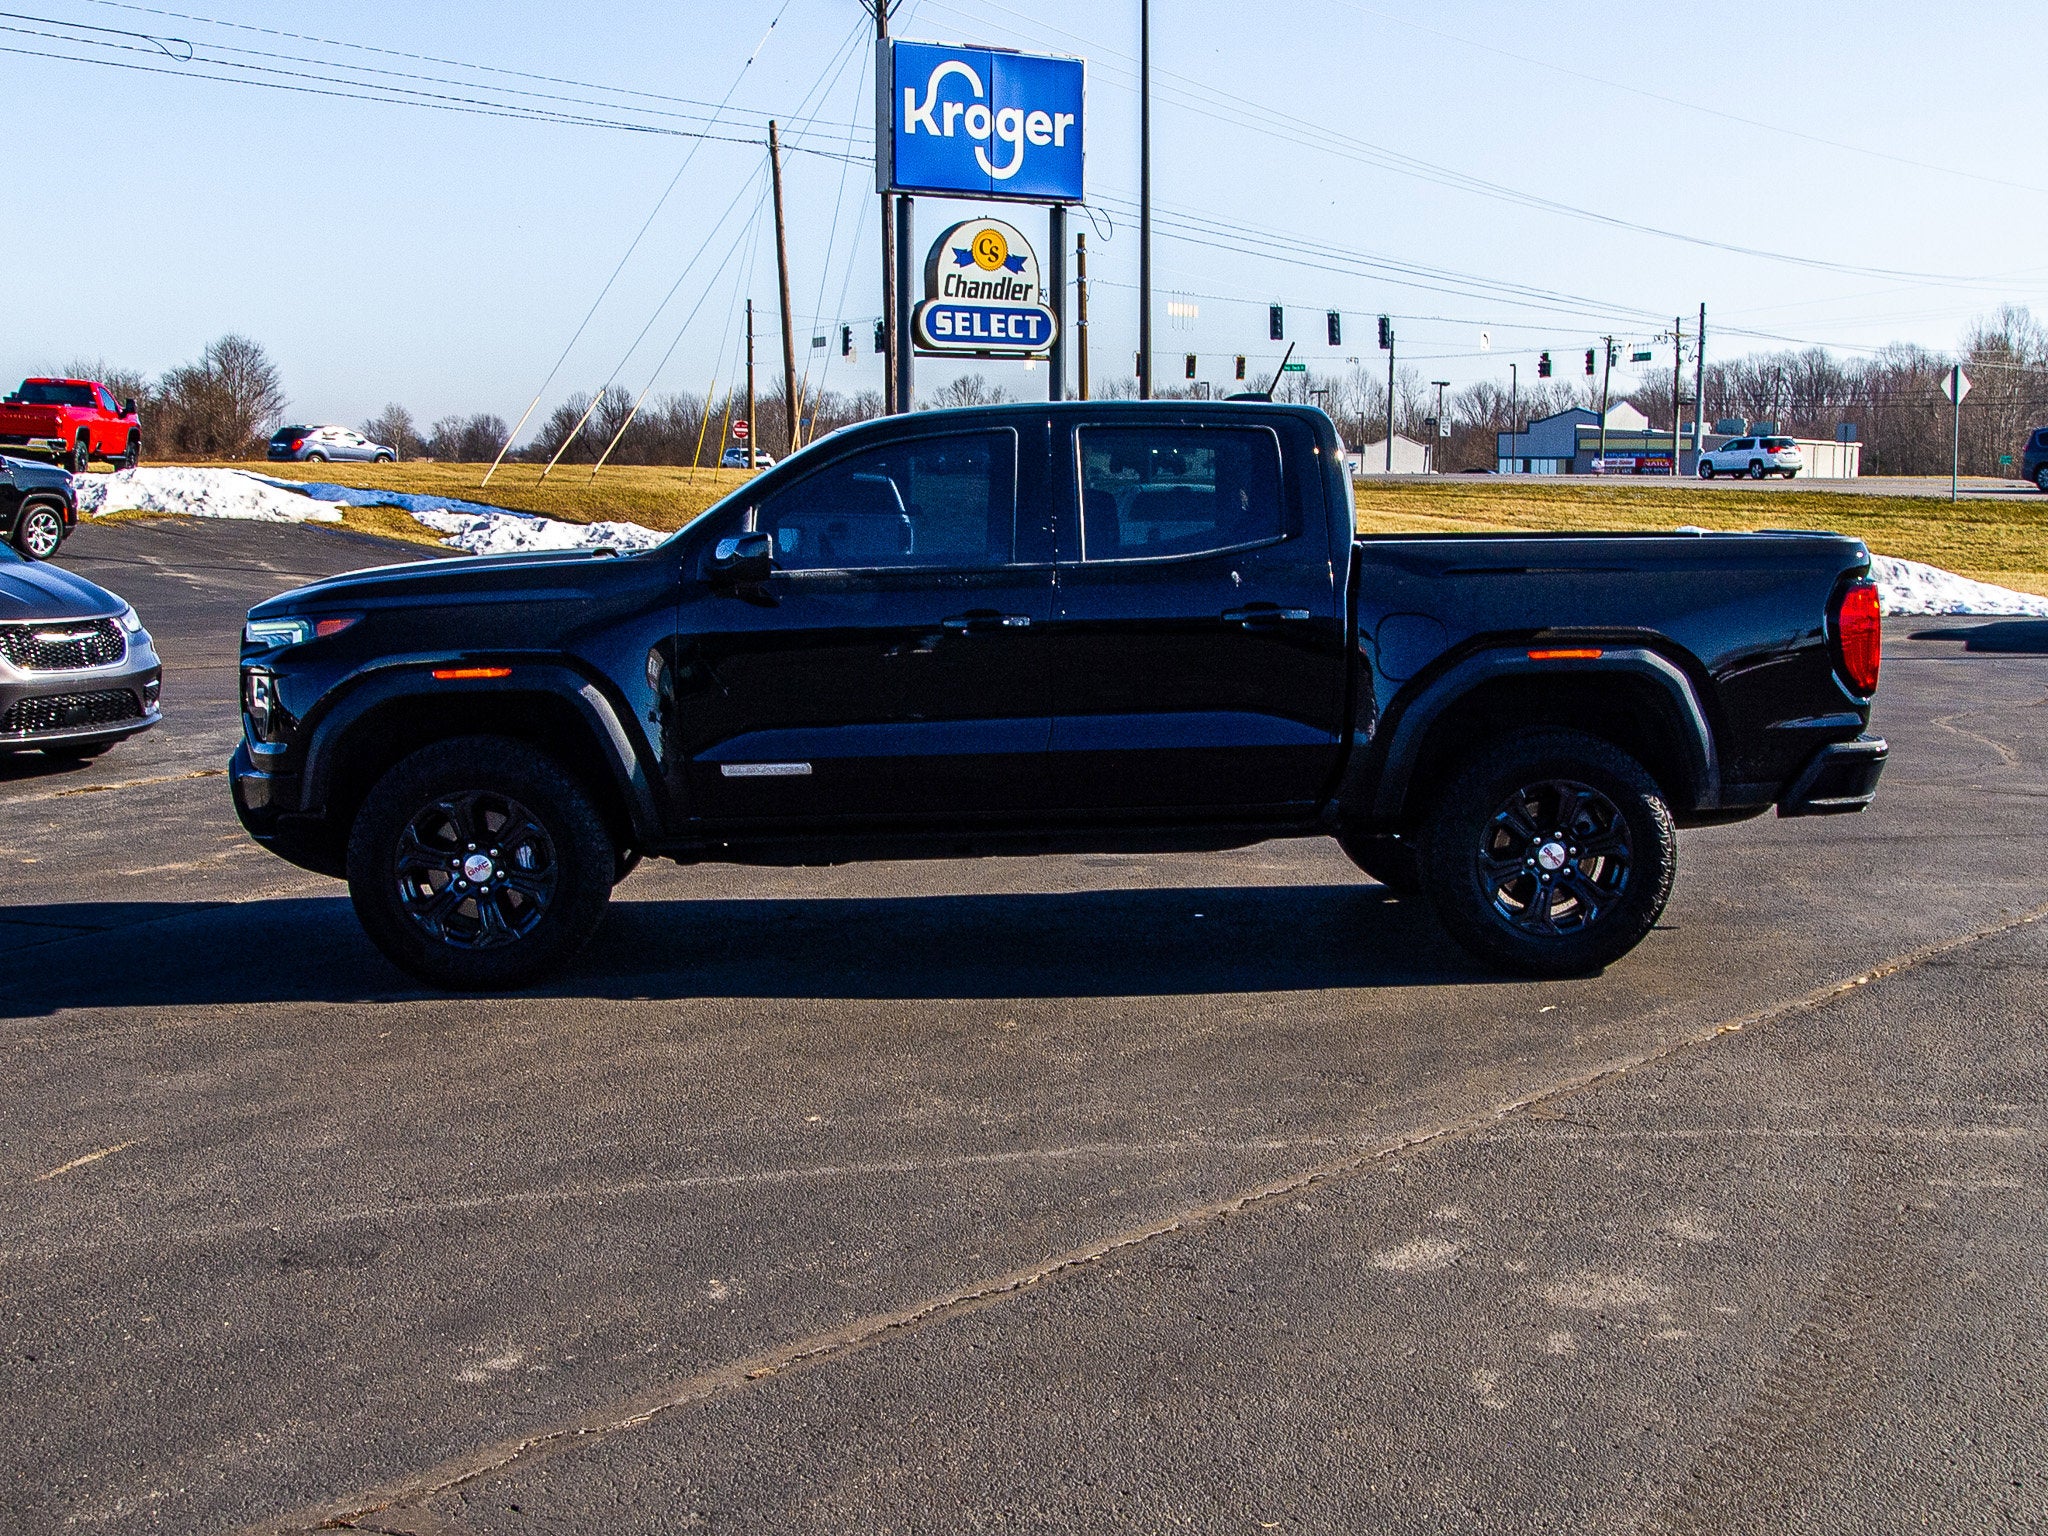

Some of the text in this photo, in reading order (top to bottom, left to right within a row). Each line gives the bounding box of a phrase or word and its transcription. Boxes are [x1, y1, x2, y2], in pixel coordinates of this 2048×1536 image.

[904, 60, 1075, 180] Kroger
[979, 238, 999, 262] CS
[944, 273, 1034, 301] Chandler
[935, 311, 1042, 339] SELECT
[467, 860, 489, 876] GMC
[1543, 847, 1562, 866] GMC
